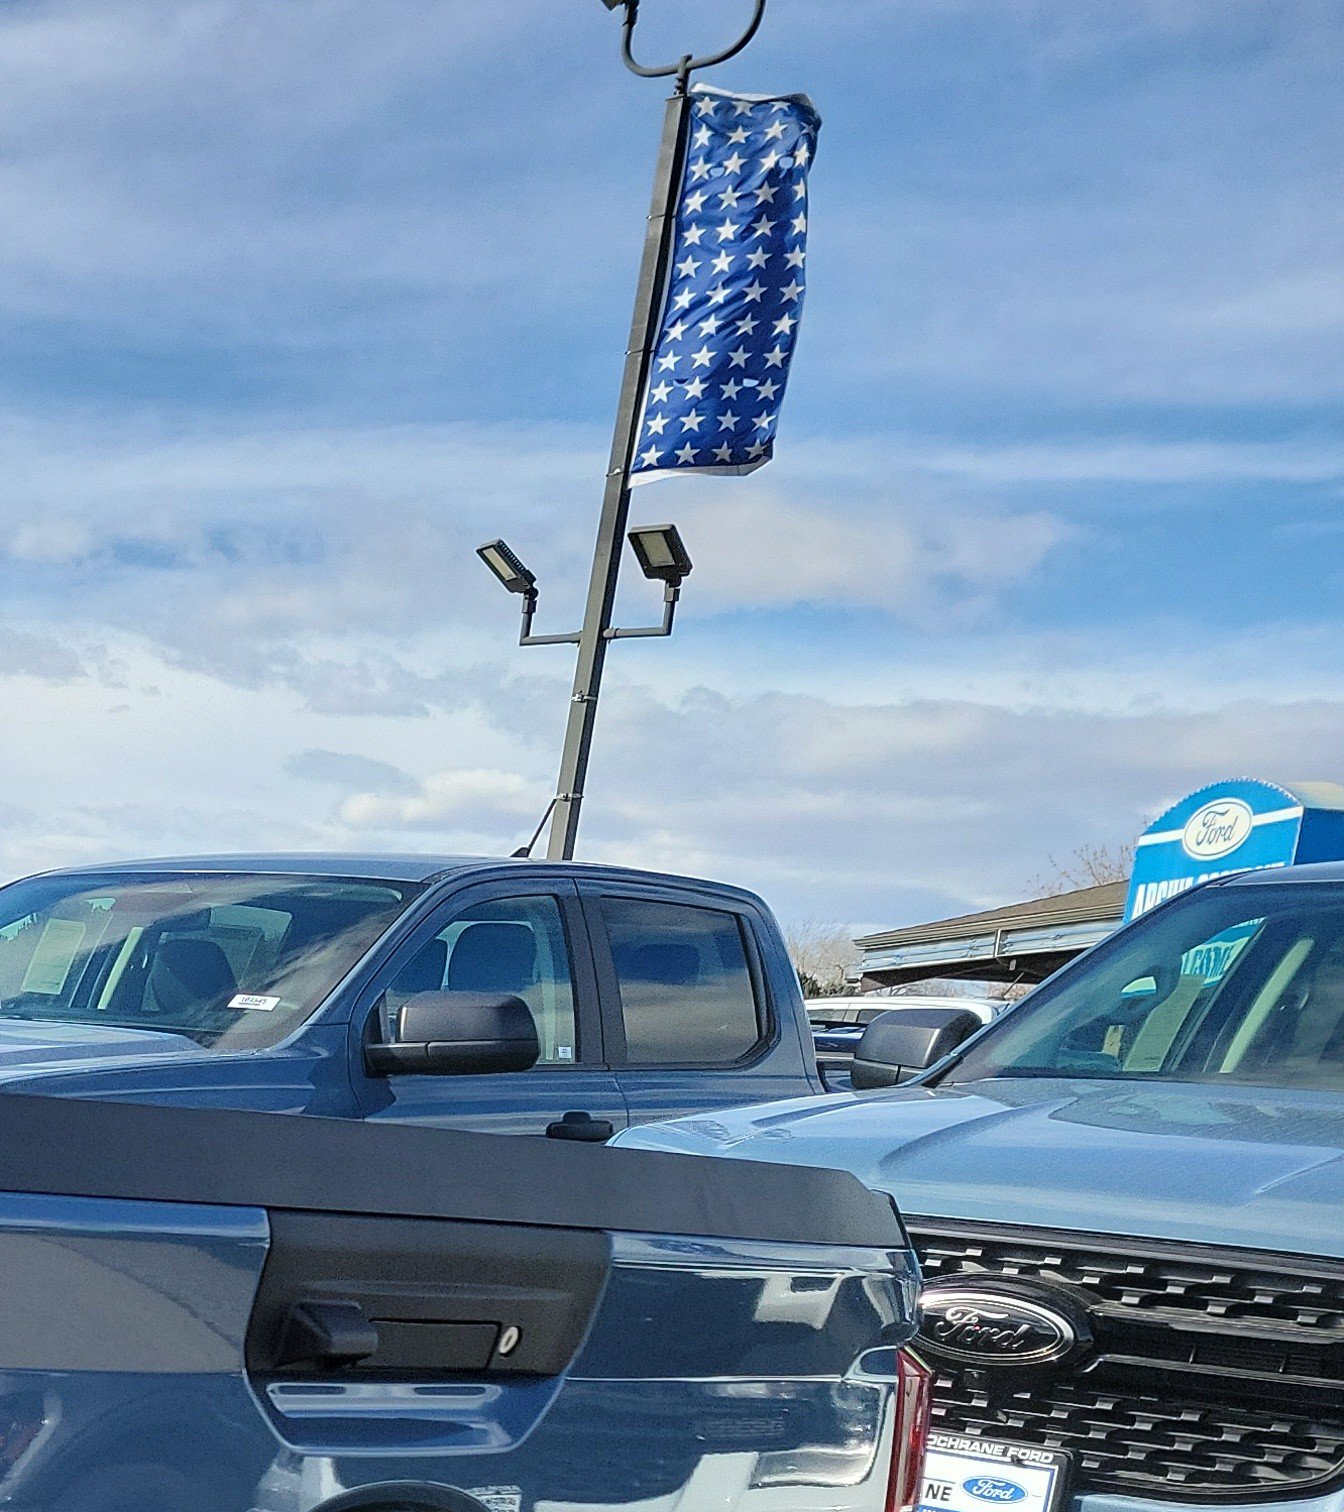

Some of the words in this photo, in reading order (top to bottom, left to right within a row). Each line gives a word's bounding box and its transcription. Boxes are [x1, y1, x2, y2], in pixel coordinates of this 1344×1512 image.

[1195, 809, 1238, 846] Ford
[934, 1307, 1030, 1349] Ford
[1006, 1448, 1053, 1464] FORD
[972, 1479, 1014, 1500] Ford
